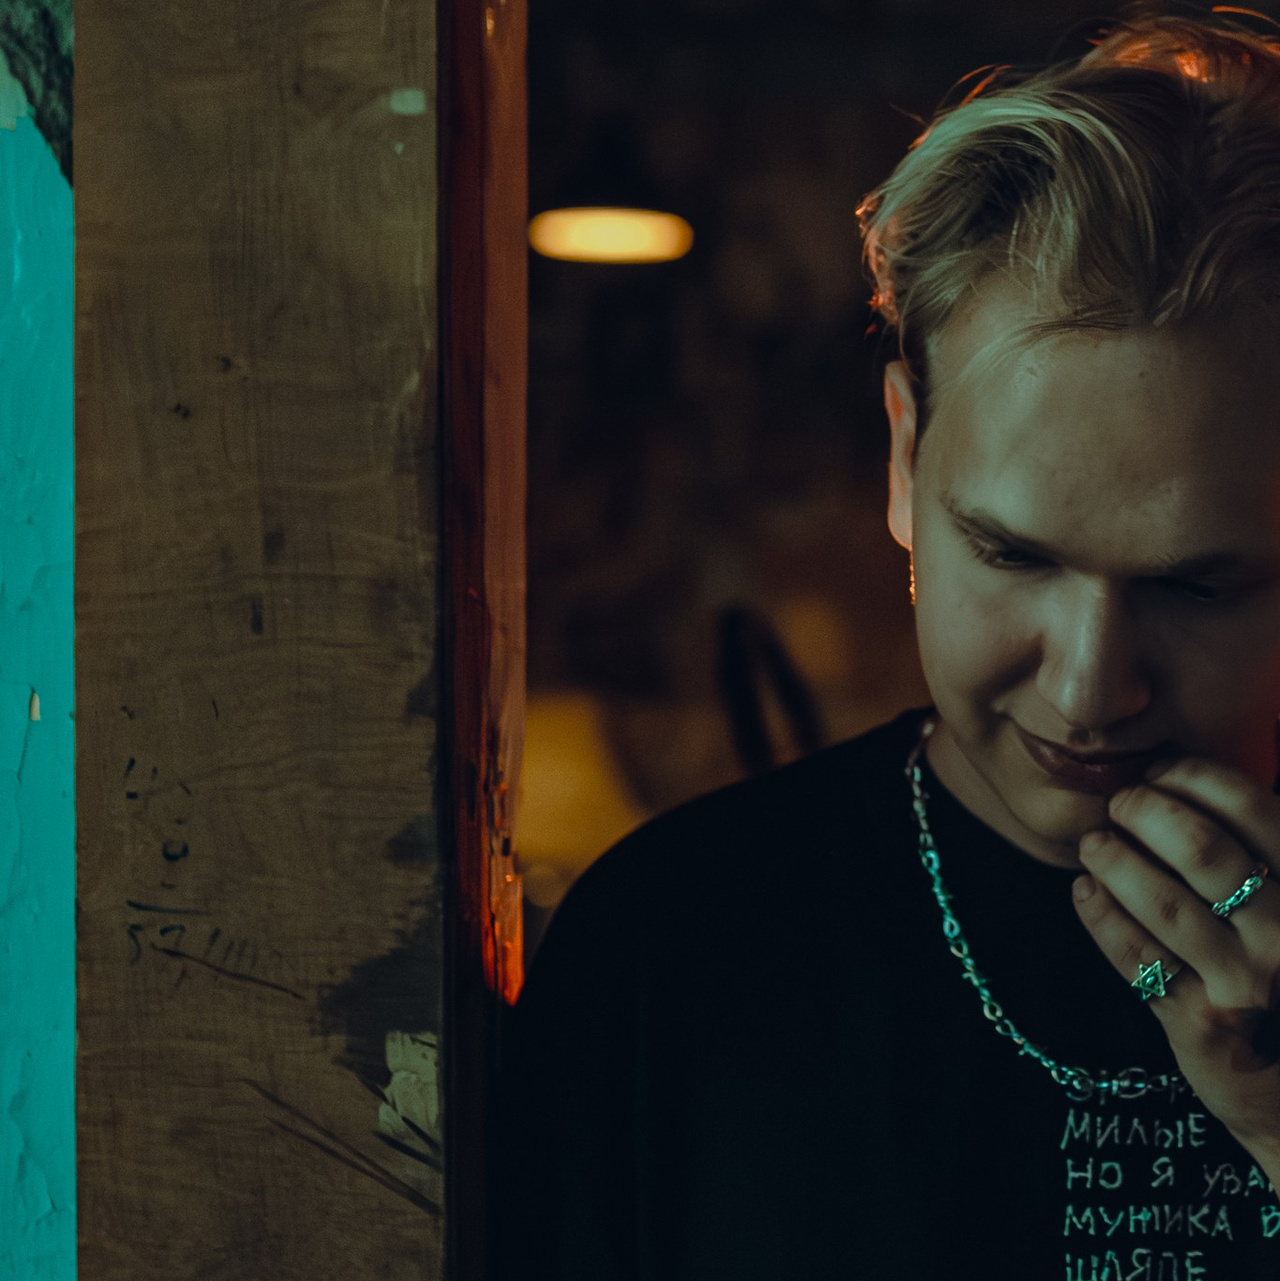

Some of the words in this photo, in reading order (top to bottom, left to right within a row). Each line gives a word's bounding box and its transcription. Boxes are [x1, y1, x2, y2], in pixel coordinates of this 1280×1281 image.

[1059, 1106, 1210, 1151] МИЛЫЕ
[1065, 1156, 1124, 1191] НО
[1150, 1155, 1175, 1188] Я
[1202, 1160, 1274, 1198] УВА
